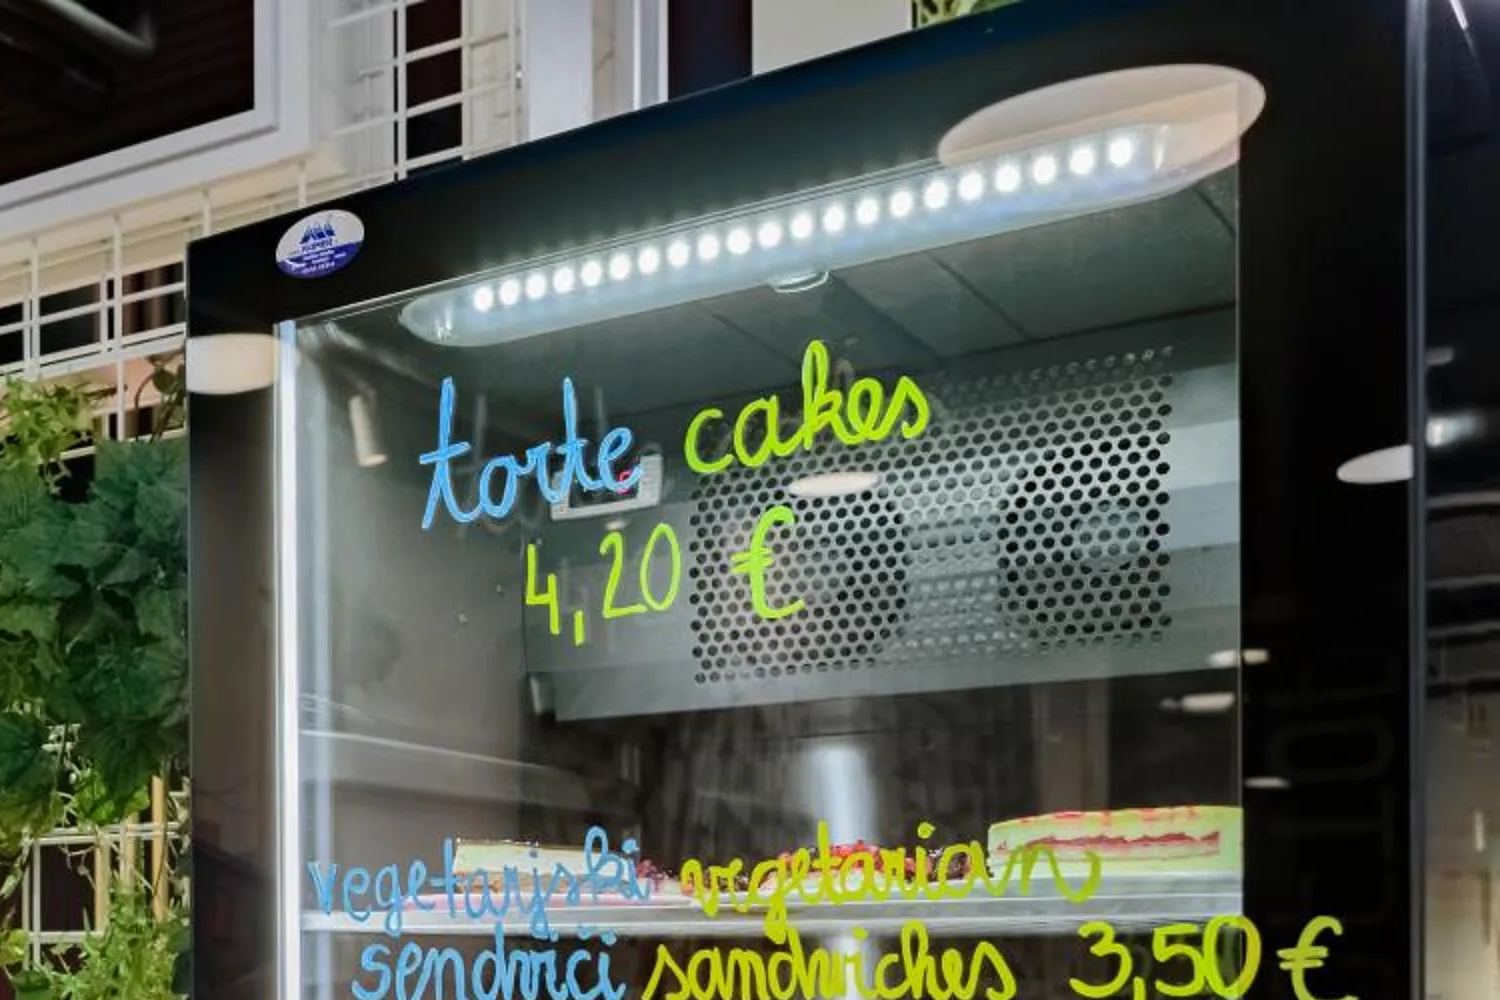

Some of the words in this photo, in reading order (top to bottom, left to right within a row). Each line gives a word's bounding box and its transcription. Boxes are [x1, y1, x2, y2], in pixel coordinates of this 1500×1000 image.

[419, 377, 645, 530] torte
[684, 338, 933, 475] cakes
[524, 523, 682, 645] 4,20
[730, 505, 806, 621] €
